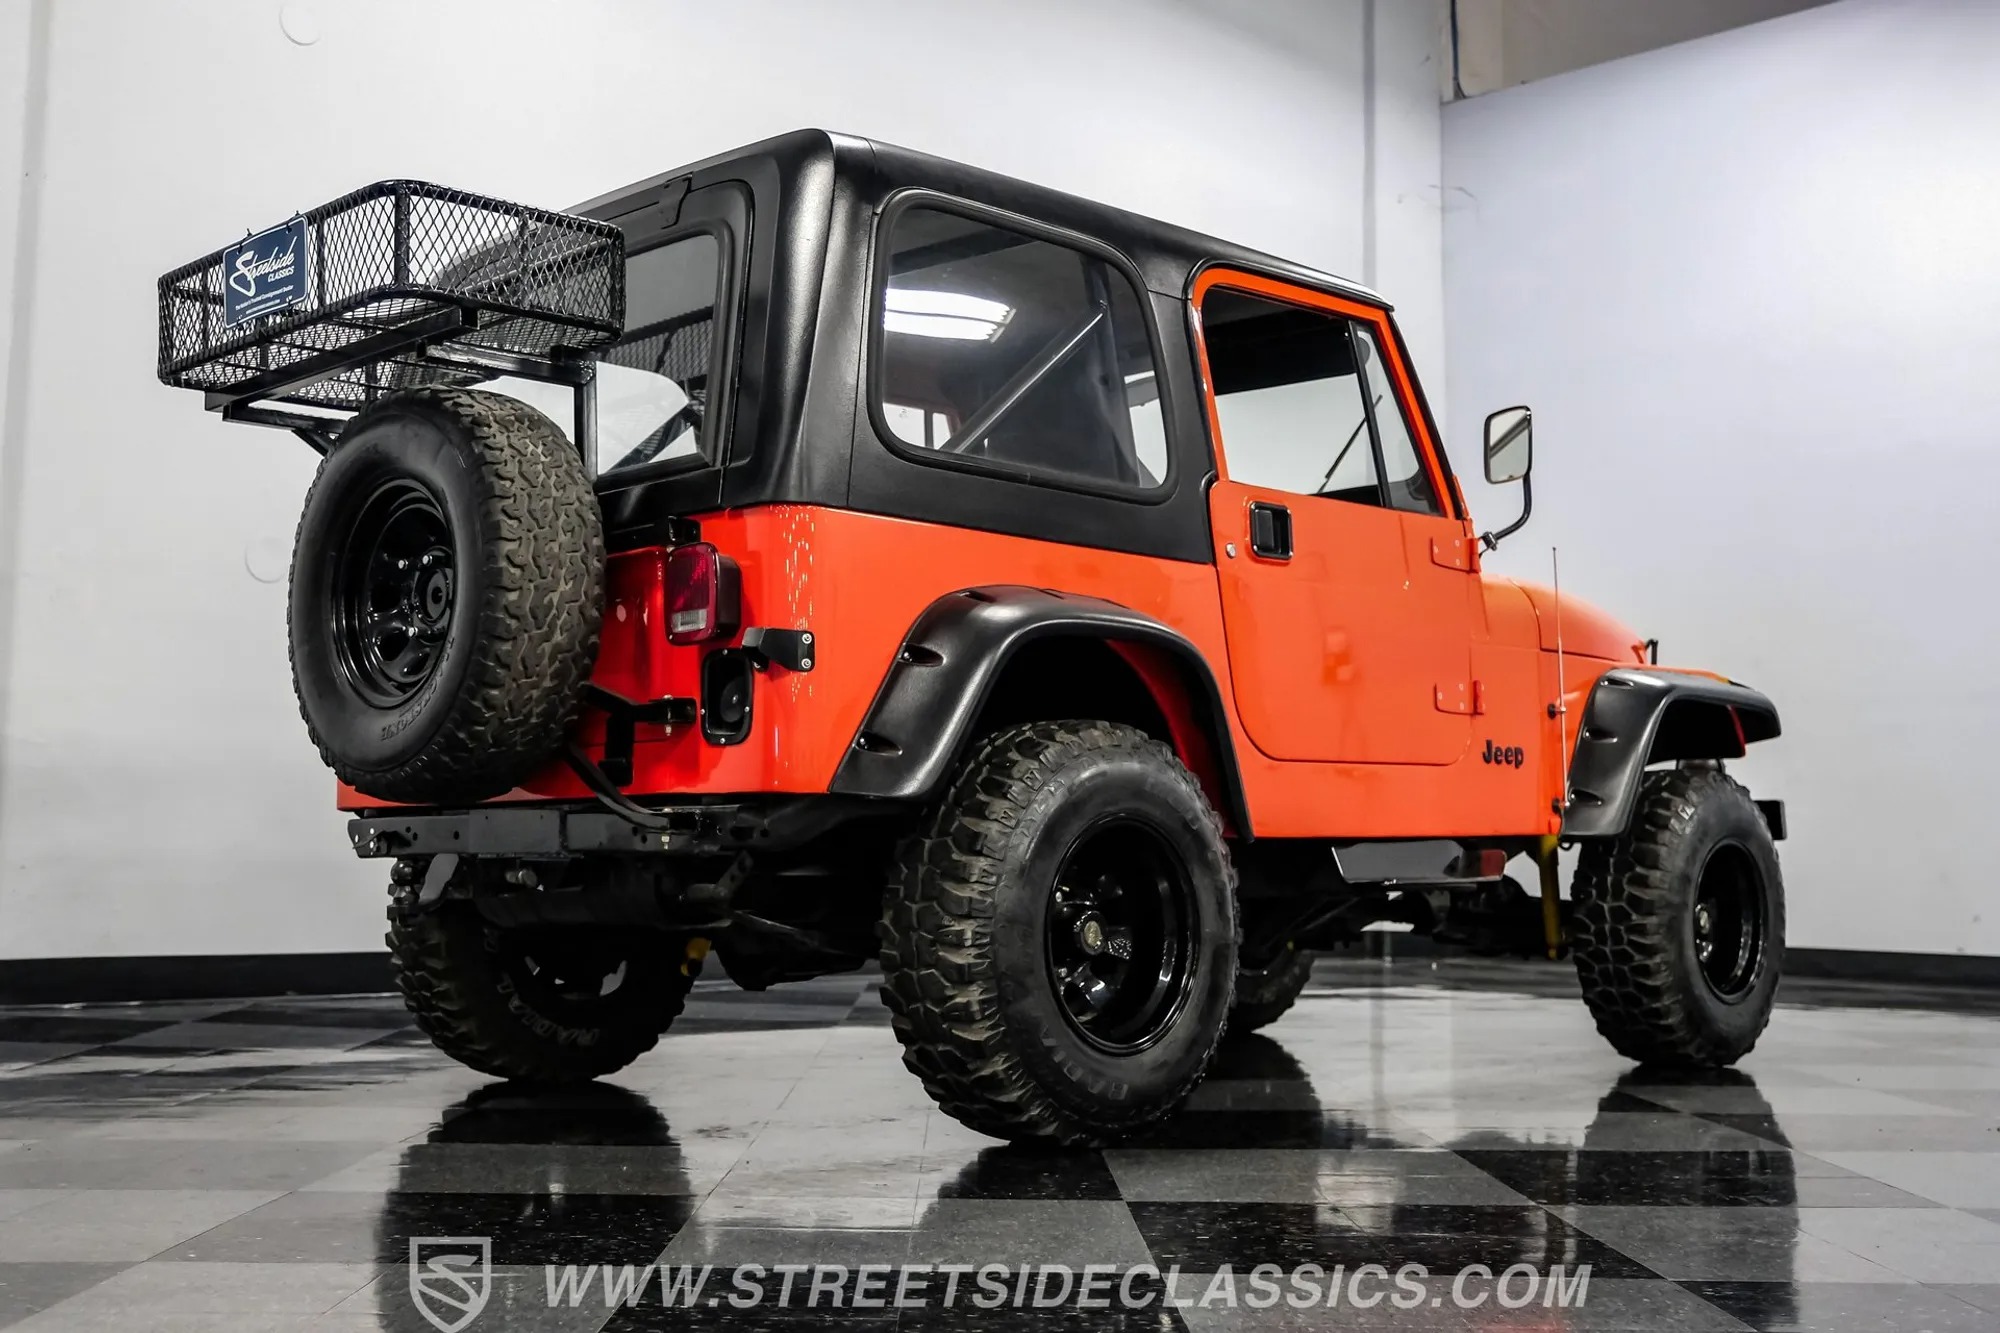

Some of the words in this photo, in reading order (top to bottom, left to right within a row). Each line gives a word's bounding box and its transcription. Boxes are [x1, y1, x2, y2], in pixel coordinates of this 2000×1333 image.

[229, 236, 298, 297] Streetside
[267, 266, 295, 283] CLASSICS
[1482, 739, 1524, 769] Jeep
